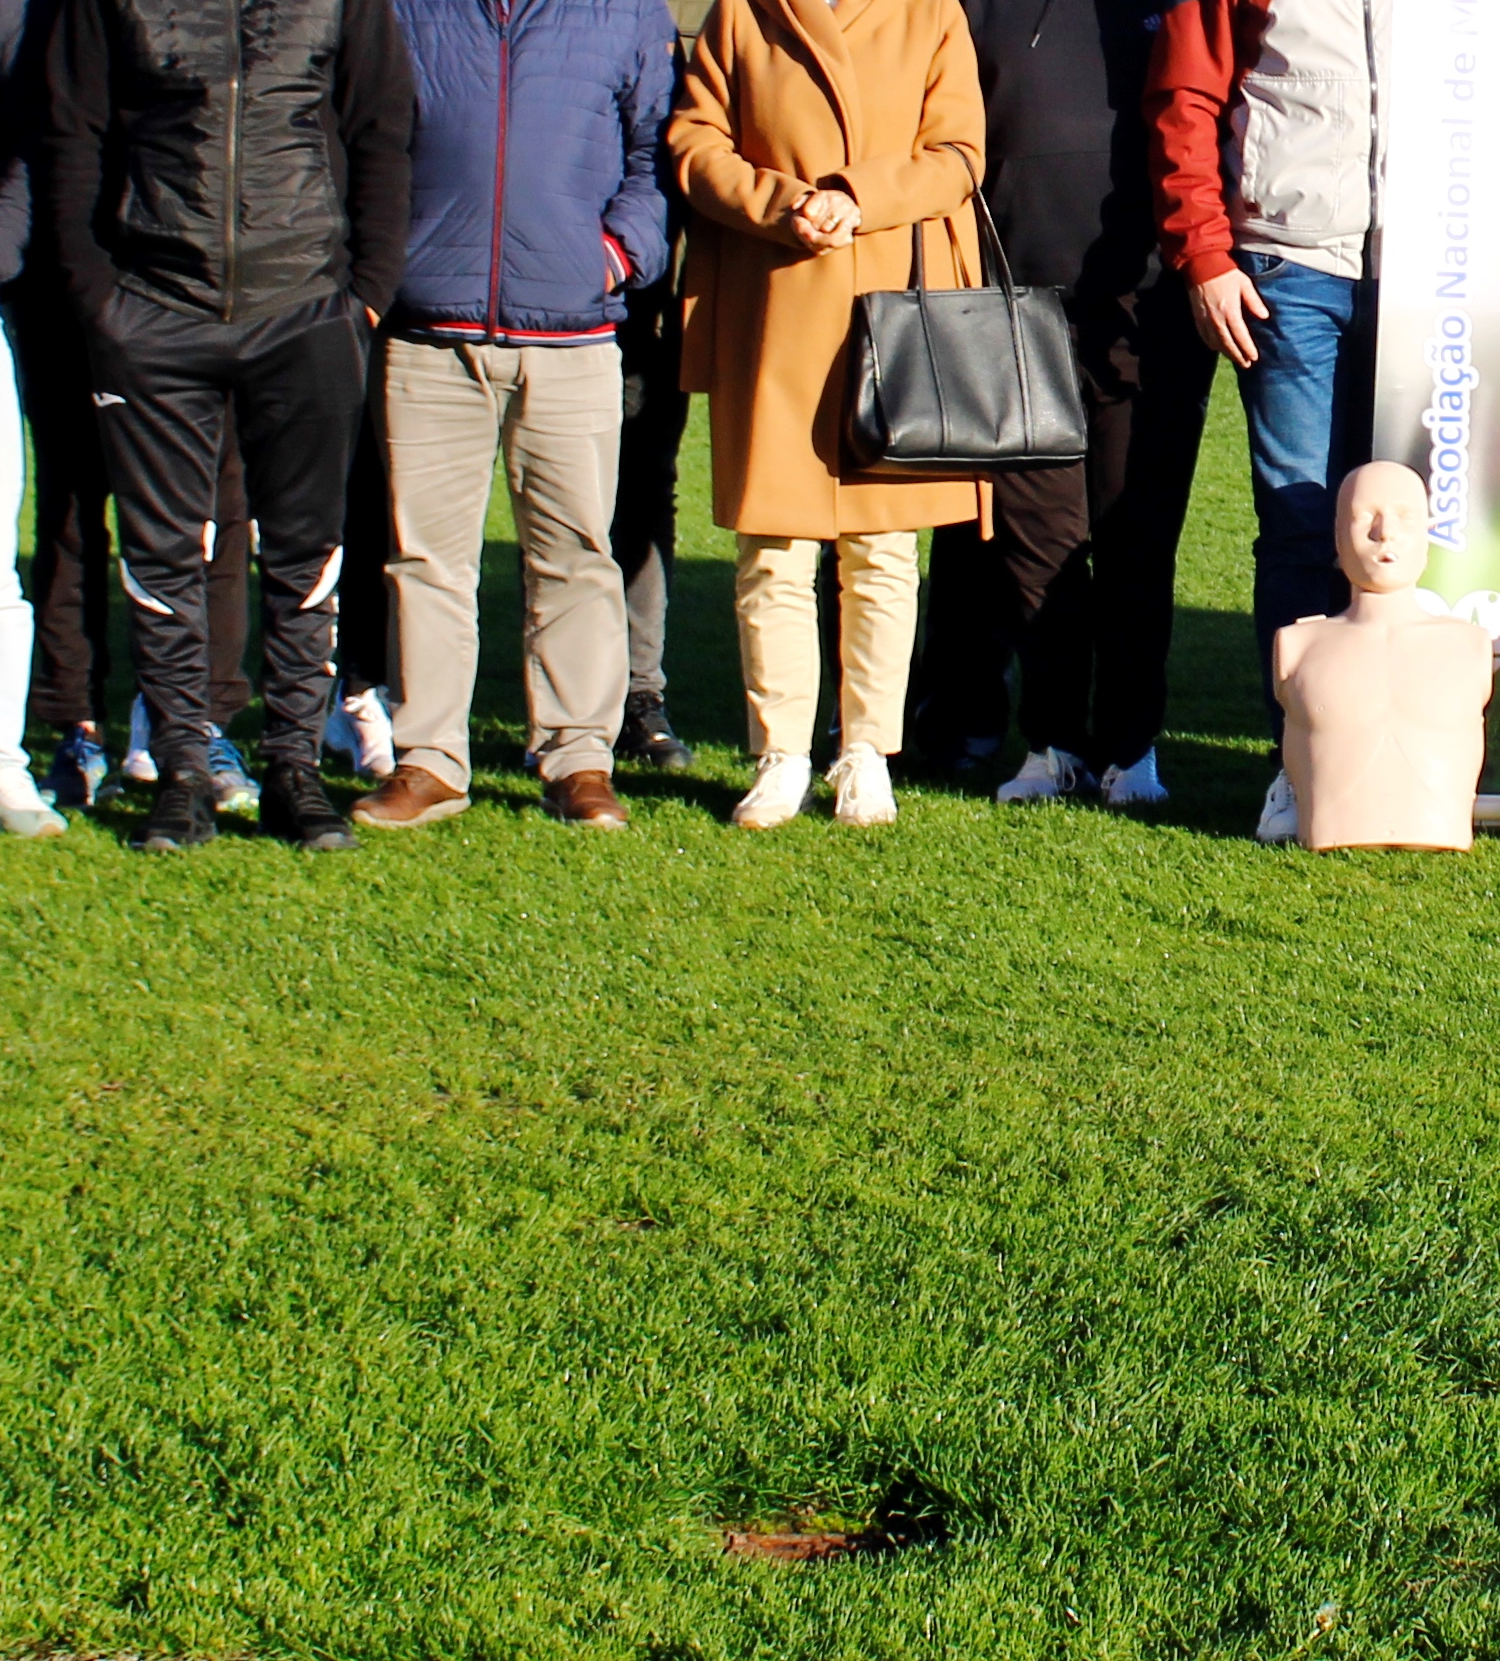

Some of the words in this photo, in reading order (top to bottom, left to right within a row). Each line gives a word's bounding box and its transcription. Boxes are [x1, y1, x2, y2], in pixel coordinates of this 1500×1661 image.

[1443, 50, 1477, 103] de
[1435, 117, 1473, 300] Nacional
[1426, 314, 1474, 546] Associação
